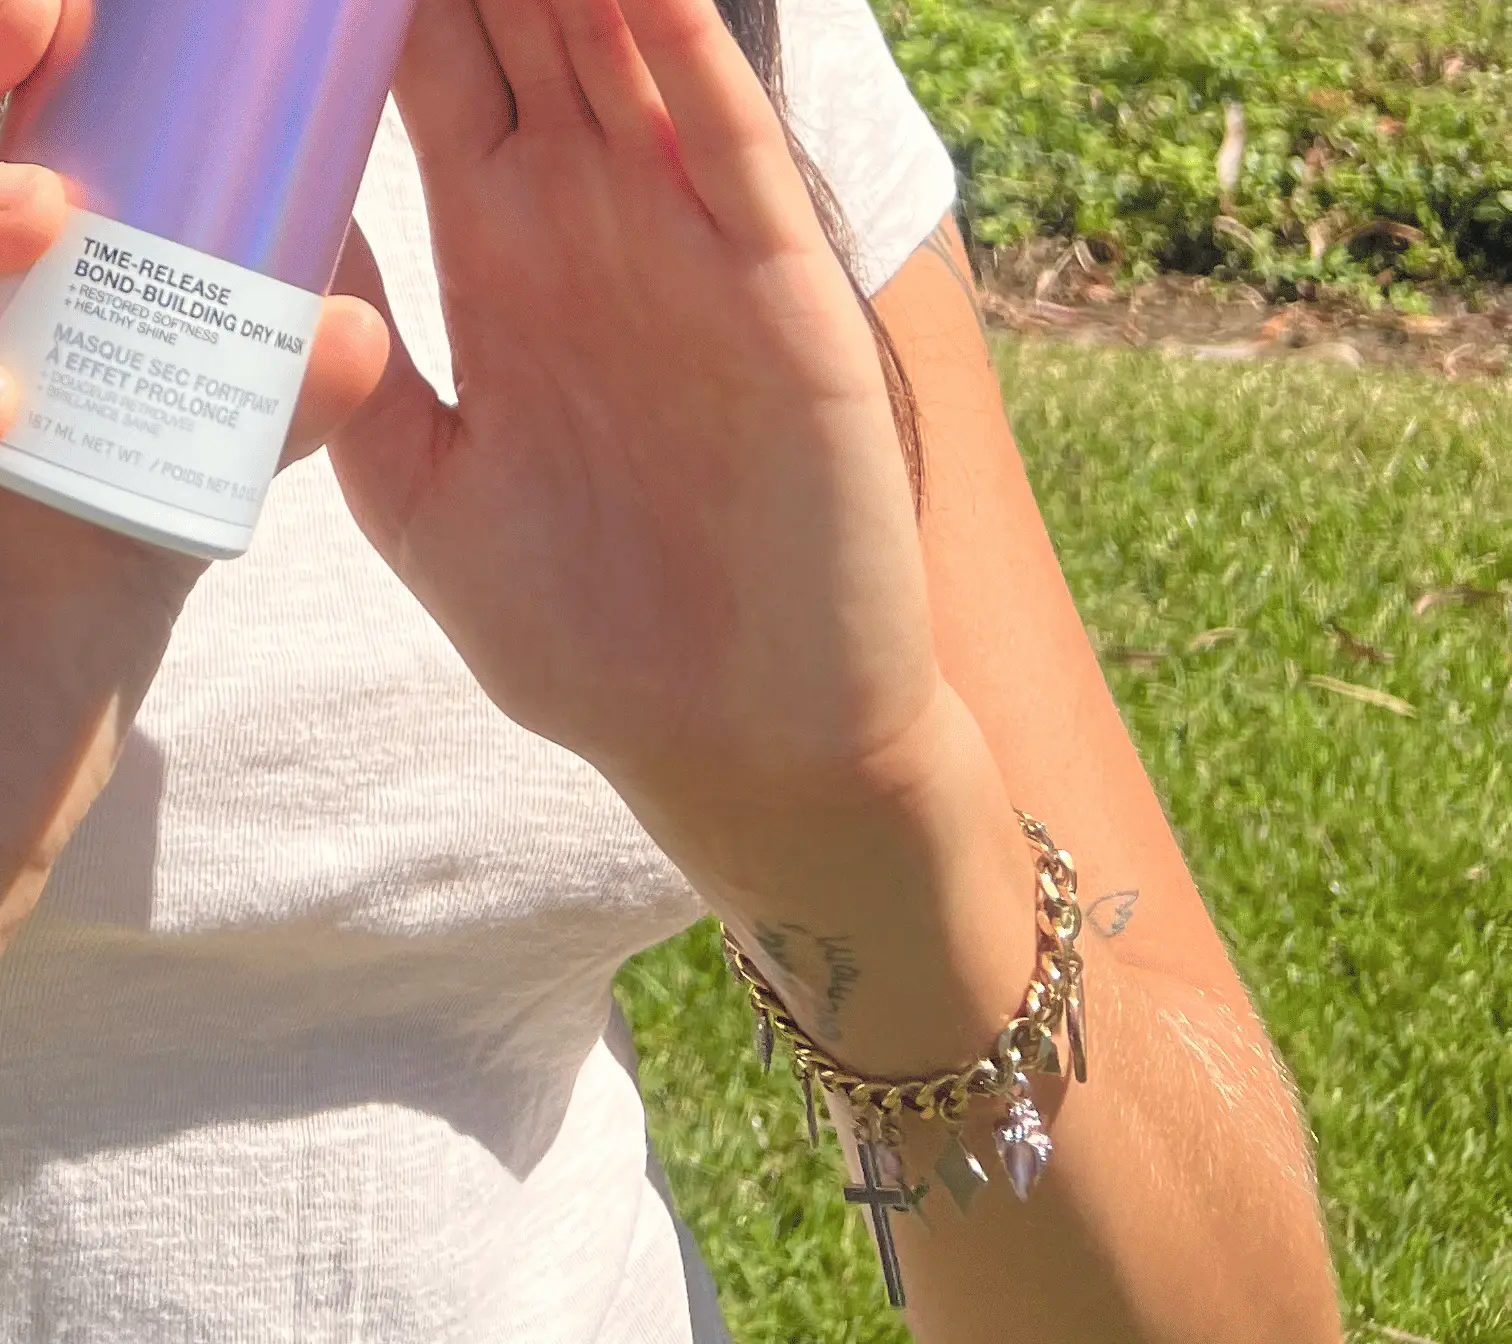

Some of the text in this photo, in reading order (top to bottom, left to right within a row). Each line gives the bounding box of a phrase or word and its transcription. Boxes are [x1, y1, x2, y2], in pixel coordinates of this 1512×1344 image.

[74, 258, 238, 332] BOND-BUILDING
[240, 320, 277, 345] DRY
[83, 237, 232, 306] TIME-RELEASE
[73, 297, 135, 330] HEALTHY
[137, 321, 180, 346] SHINE
[79, 283, 150, 319] RESTORED
[152, 311, 220, 345] SOFTNESS
[53, 323, 280, 418] MASQUE SEC FORTIFIANT
[64, 351, 132, 389] EFFET
[54, 421, 77, 445] ML
[81, 433, 116, 457] NET
[161, 460, 205, 490] POIDS
